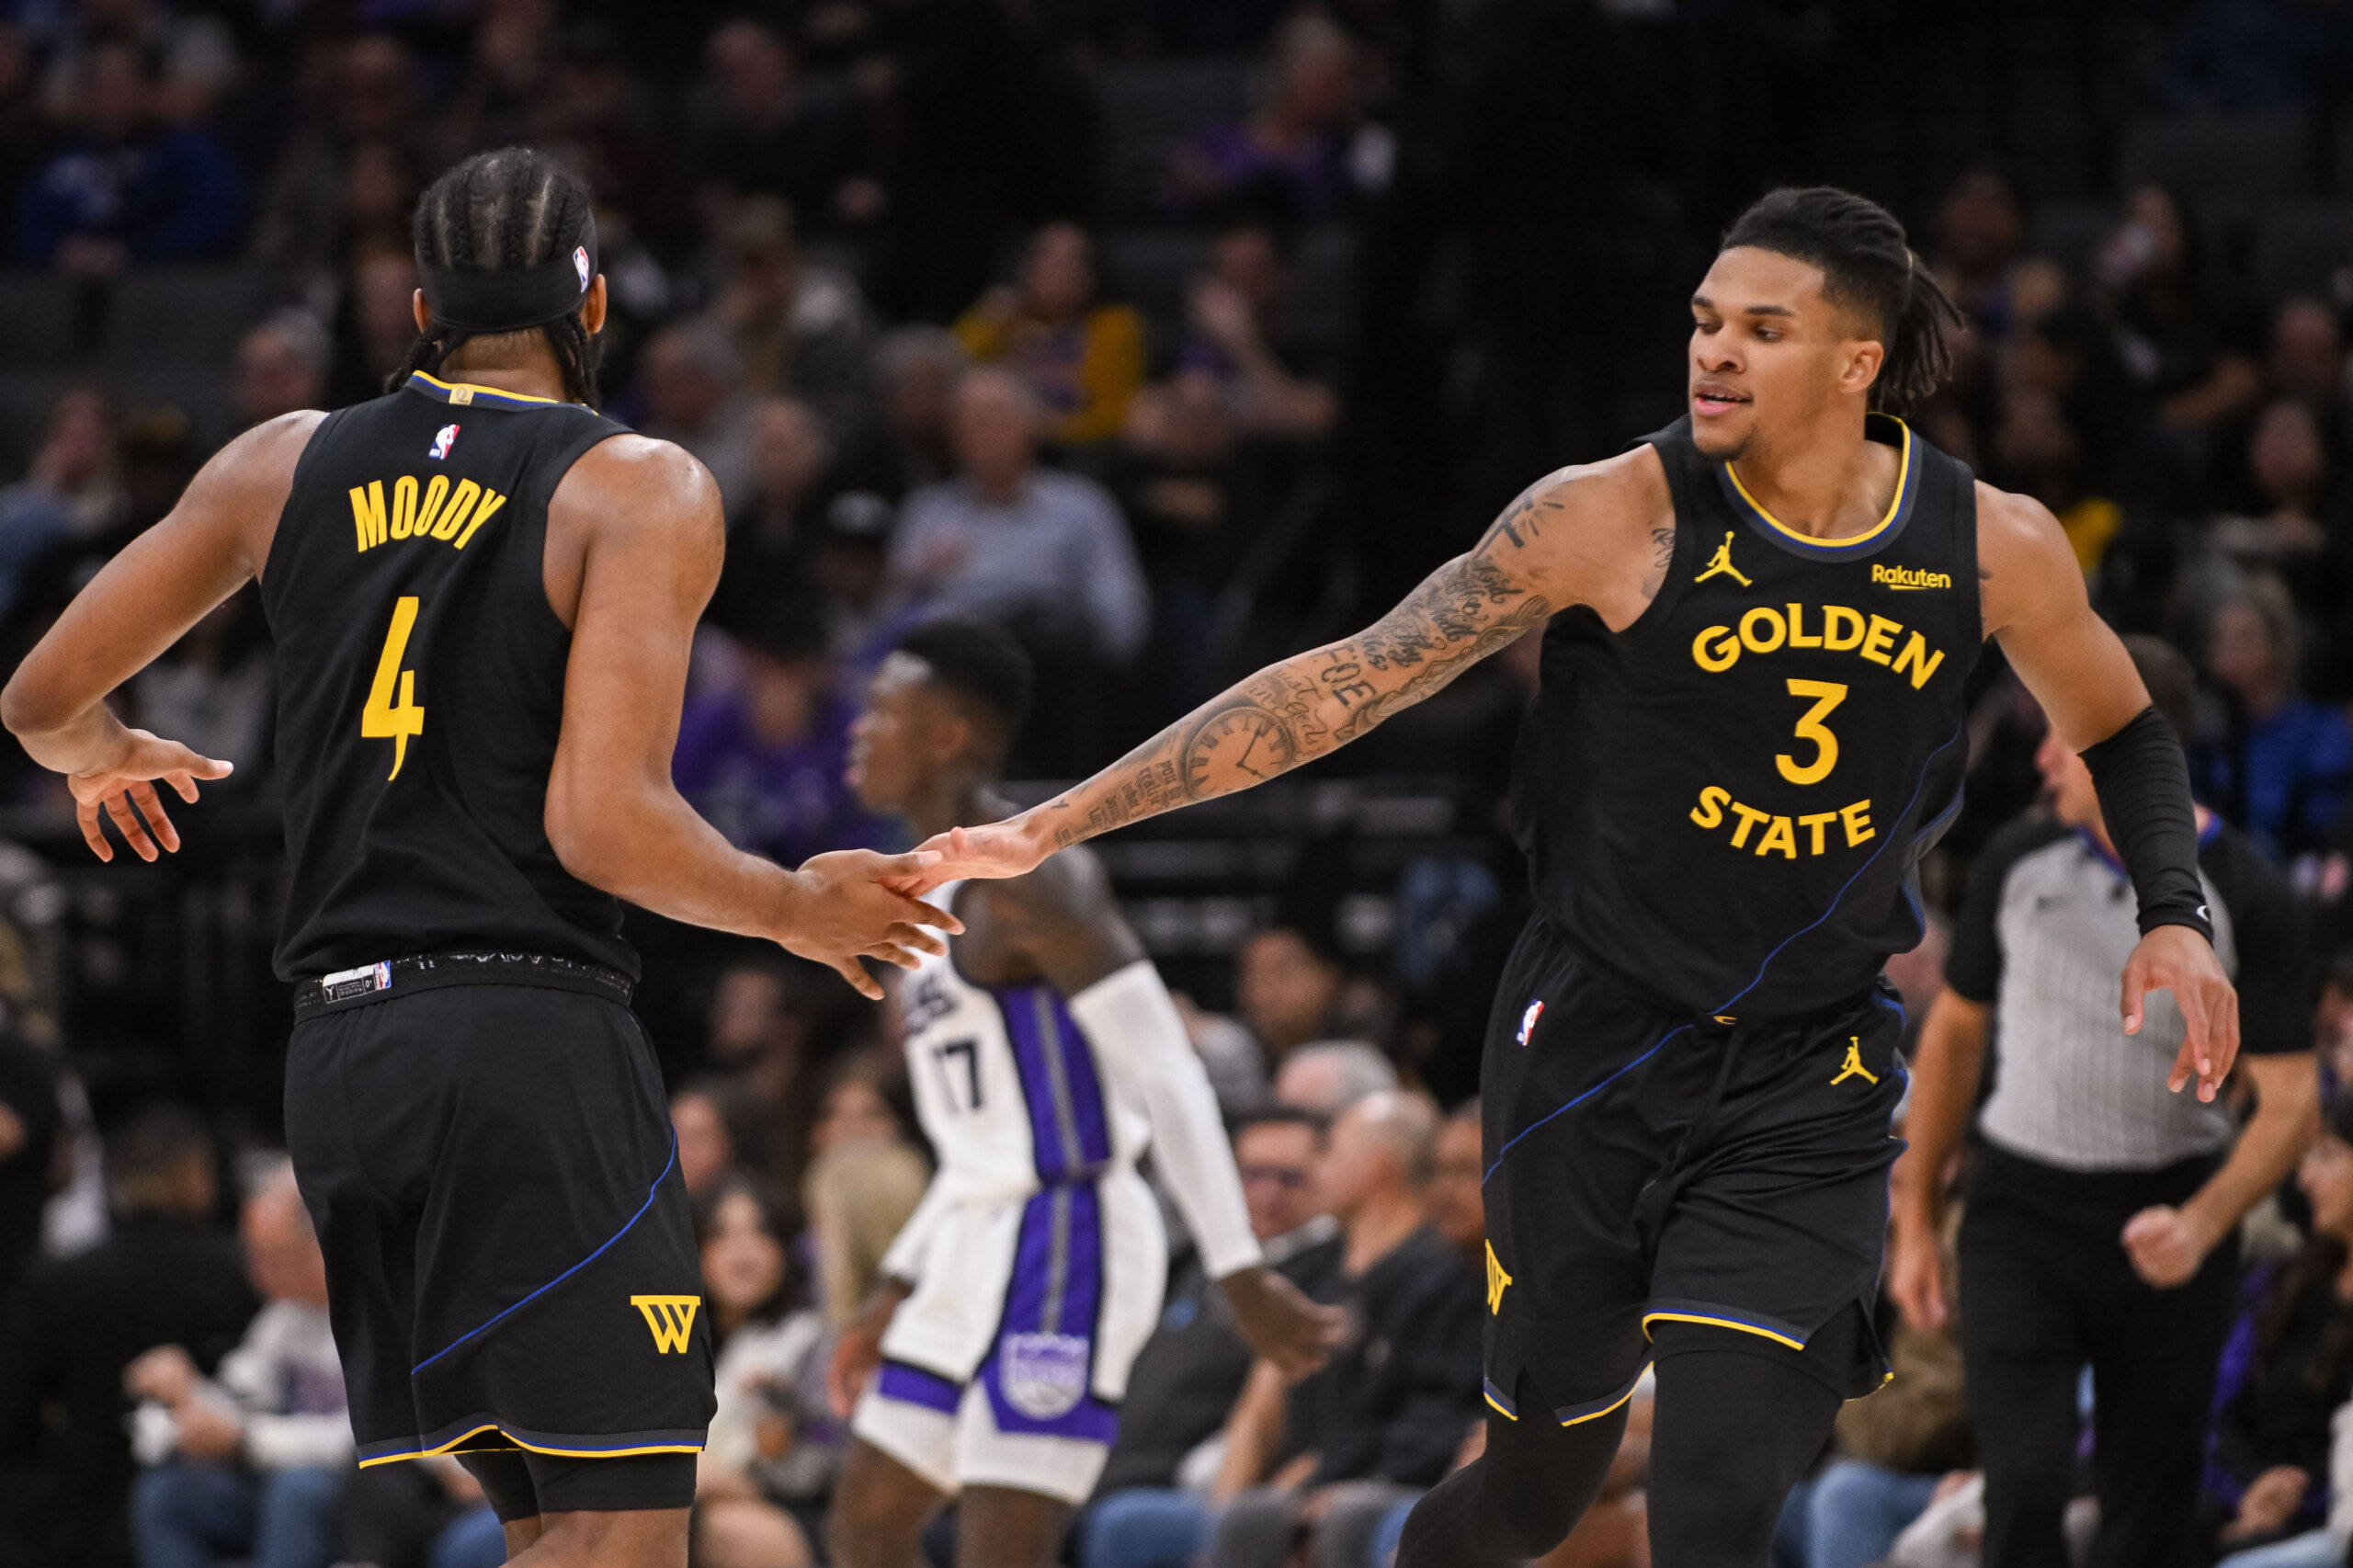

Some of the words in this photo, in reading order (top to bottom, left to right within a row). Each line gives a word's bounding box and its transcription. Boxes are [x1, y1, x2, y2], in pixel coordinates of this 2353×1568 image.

[348, 474, 507, 553] MOODY
[1871, 563, 1952, 591] Rakuten
[1691, 602, 1946, 691] GOLDEN
[360, 596, 426, 782] 4
[1775, 678, 1849, 785] 3
[1689, 785, 1877, 860] STATE
[630, 1294, 702, 1355] W
